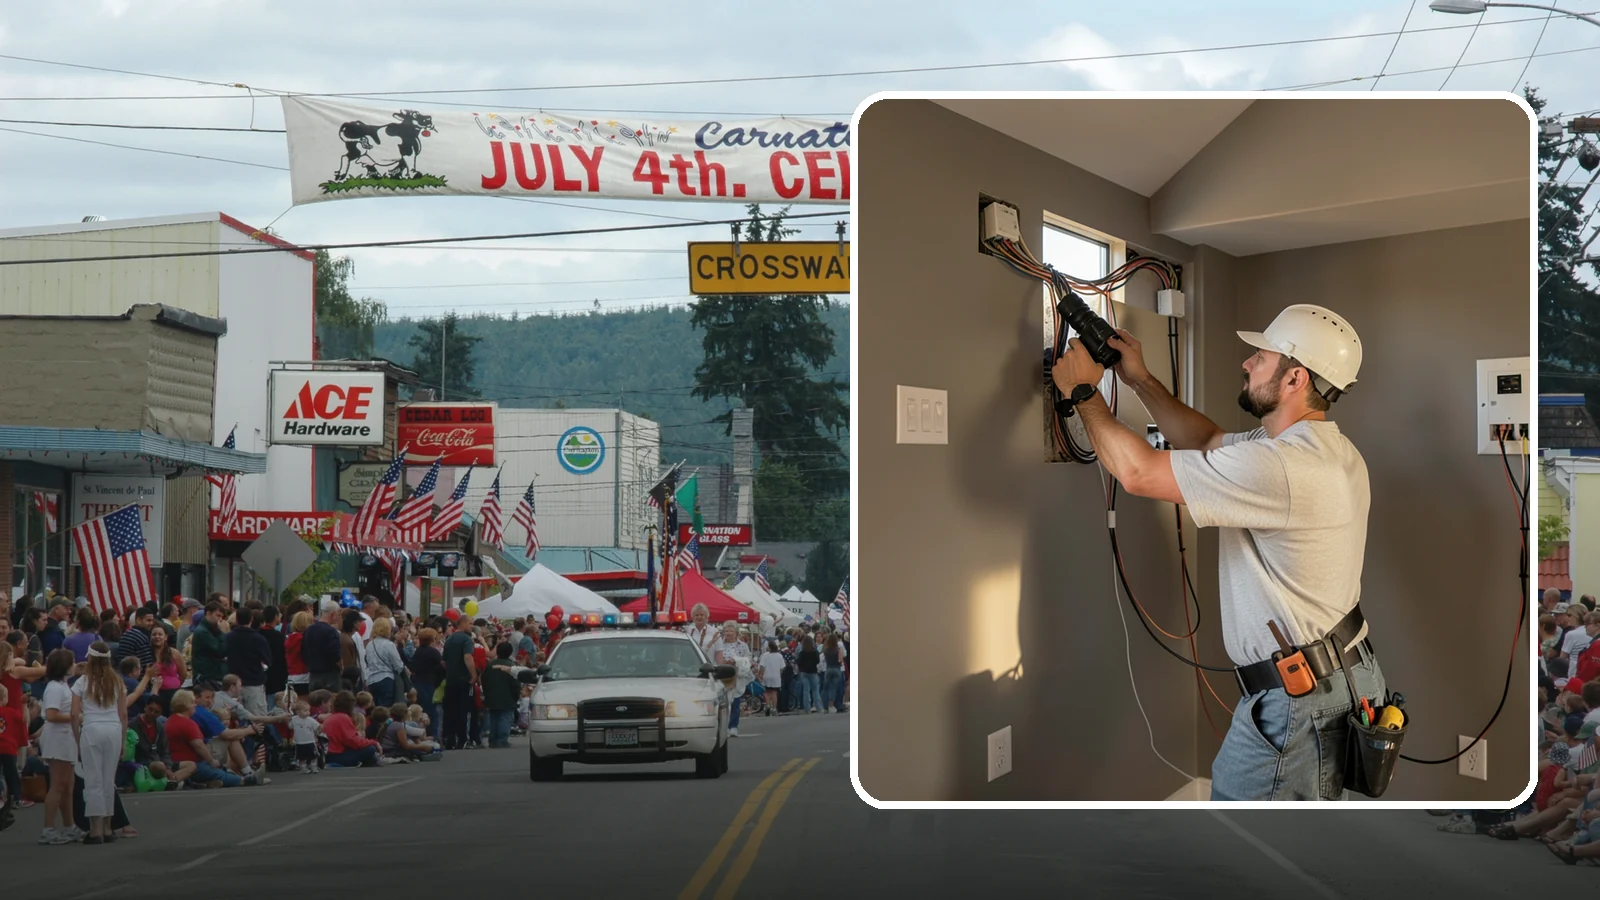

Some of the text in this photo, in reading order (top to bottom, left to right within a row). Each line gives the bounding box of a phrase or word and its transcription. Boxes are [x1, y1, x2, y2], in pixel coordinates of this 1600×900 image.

[481, 141, 604, 192] JULY
[632, 150, 746, 198] 4th.
[697, 253, 850, 280] CROSSWA
[283, 380, 374, 420] ACE
[405, 409, 452, 422] CEDAR
[283, 421, 371, 437] Hardware
[416, 428, 476, 446] Coca-Cola
[353, 467, 387, 481] Simpl
[96, 485, 124, 495] Vincent
[126, 485, 135, 495] de
[138, 486, 155, 495] Paul
[81, 503, 154, 522] THT
[688, 526, 741, 535] CRNATION
[699, 535, 730, 543] GLASS
